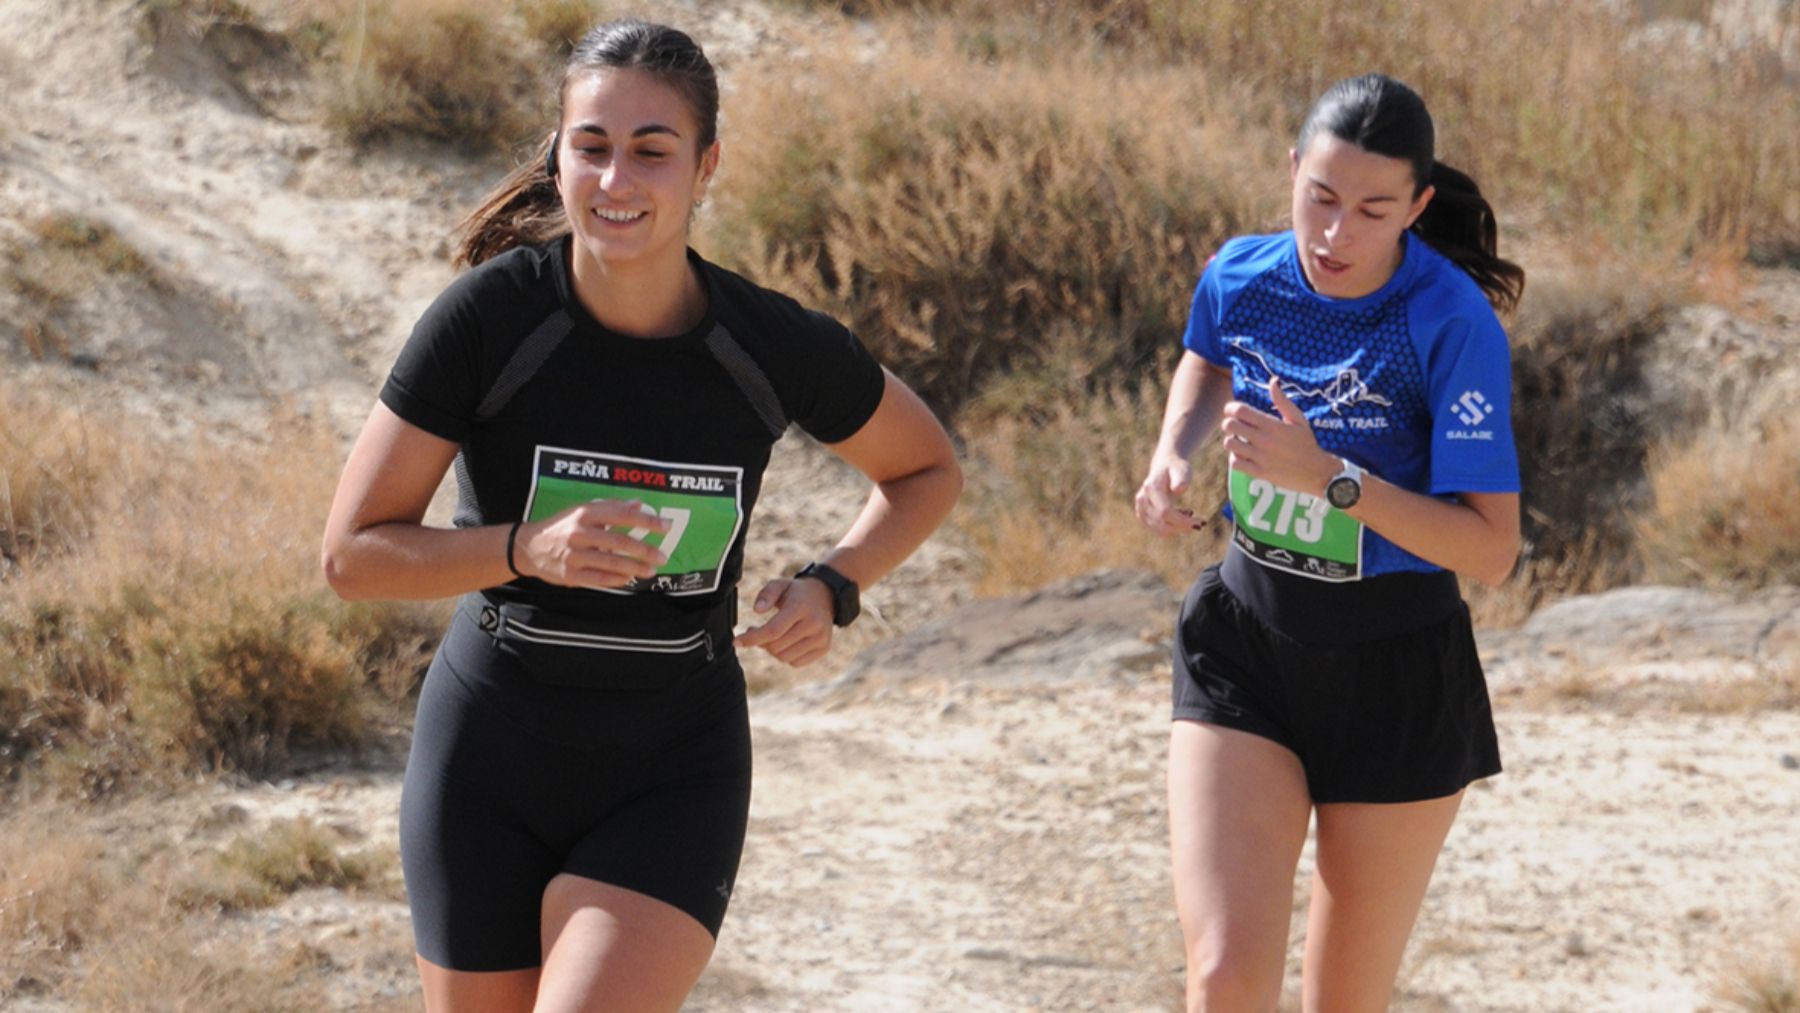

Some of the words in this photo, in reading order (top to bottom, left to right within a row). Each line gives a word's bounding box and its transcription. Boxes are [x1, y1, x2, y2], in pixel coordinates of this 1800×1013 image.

[1347, 417, 1389, 430] TRAIL
[553, 459, 610, 480] PEÑA
[613, 467, 666, 486] ROYA
[669, 474, 724, 492] TRAIL
[1248, 478, 1326, 544] 273
